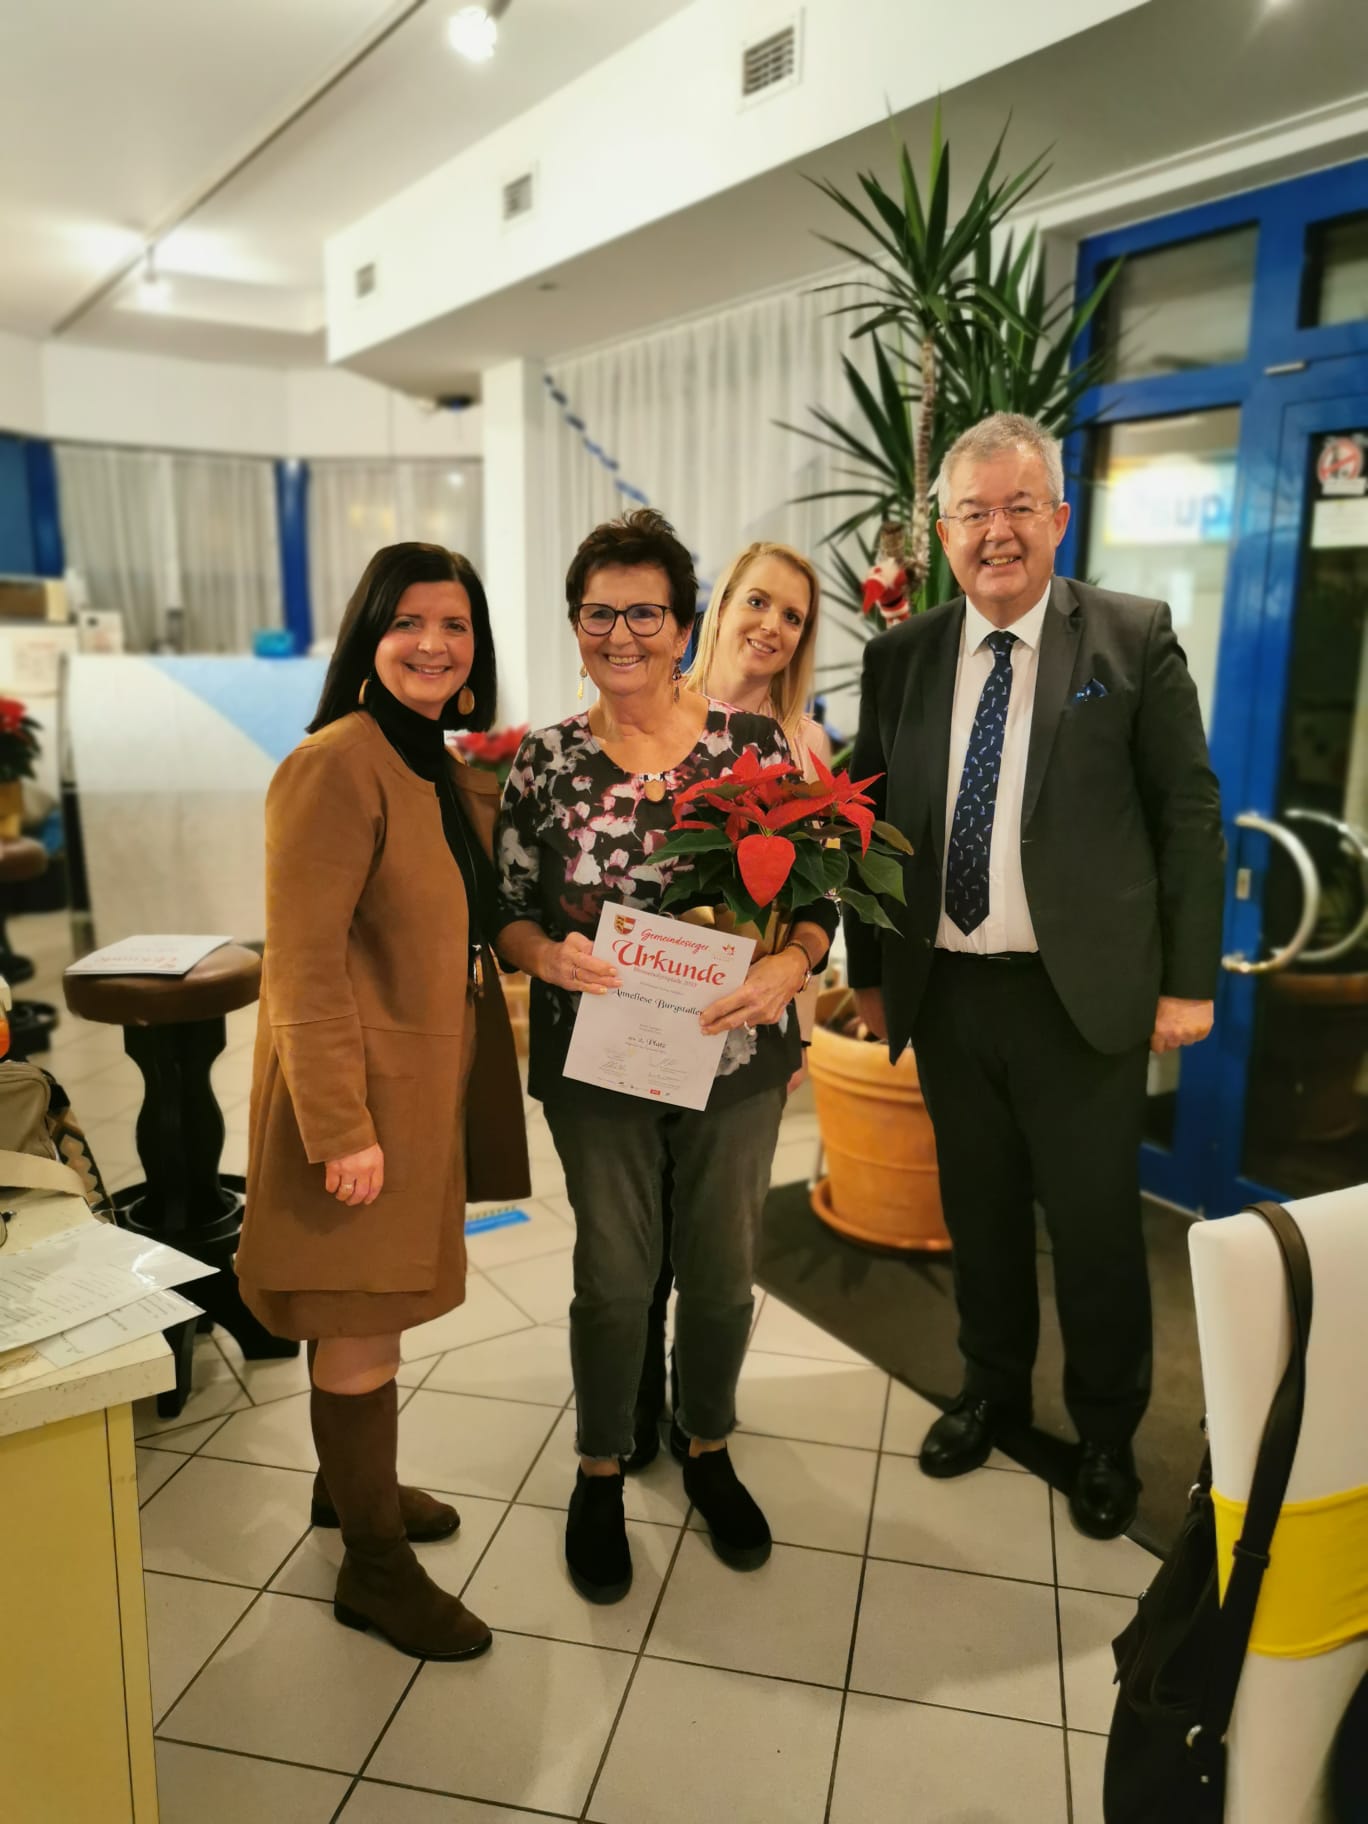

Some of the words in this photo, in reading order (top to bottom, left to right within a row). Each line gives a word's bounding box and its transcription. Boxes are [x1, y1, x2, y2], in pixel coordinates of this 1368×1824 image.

[641, 929, 709, 954] Gemeindesieger
[612, 940, 726, 985] Urkunde
[616, 988, 653, 1004] Anneliese
